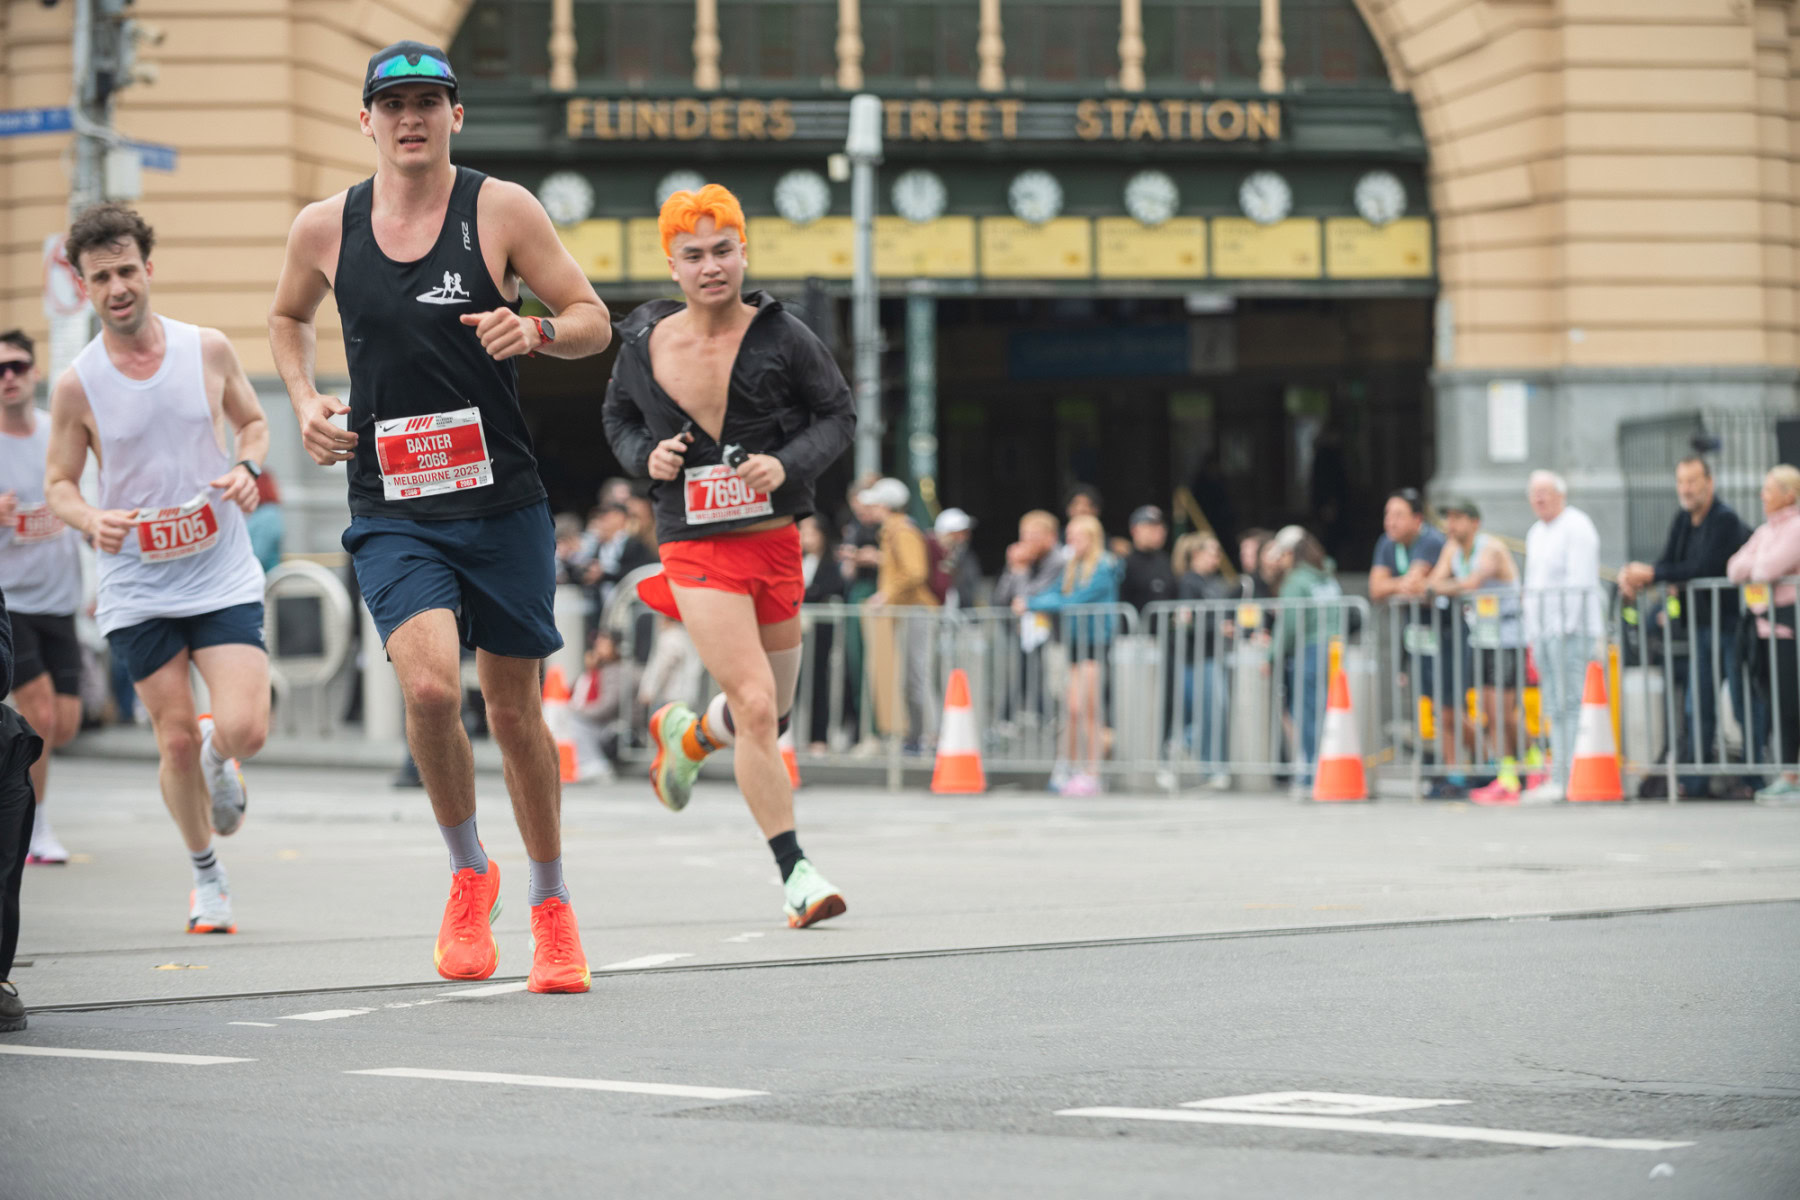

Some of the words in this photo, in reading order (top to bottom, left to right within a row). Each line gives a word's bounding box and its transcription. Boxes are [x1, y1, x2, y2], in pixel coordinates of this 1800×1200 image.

[566, 98, 796, 140] FLINDERS
[881, 99, 1023, 141] TREET
[1075, 99, 1281, 141] STATION
[461, 221, 472, 251] 2XU
[406, 433, 452, 453] BAXTER
[417, 453, 448, 469] 2068
[393, 470, 451, 486] MELBOURNE
[453, 465, 480, 477] 2025
[150, 512, 208, 549] 5705
